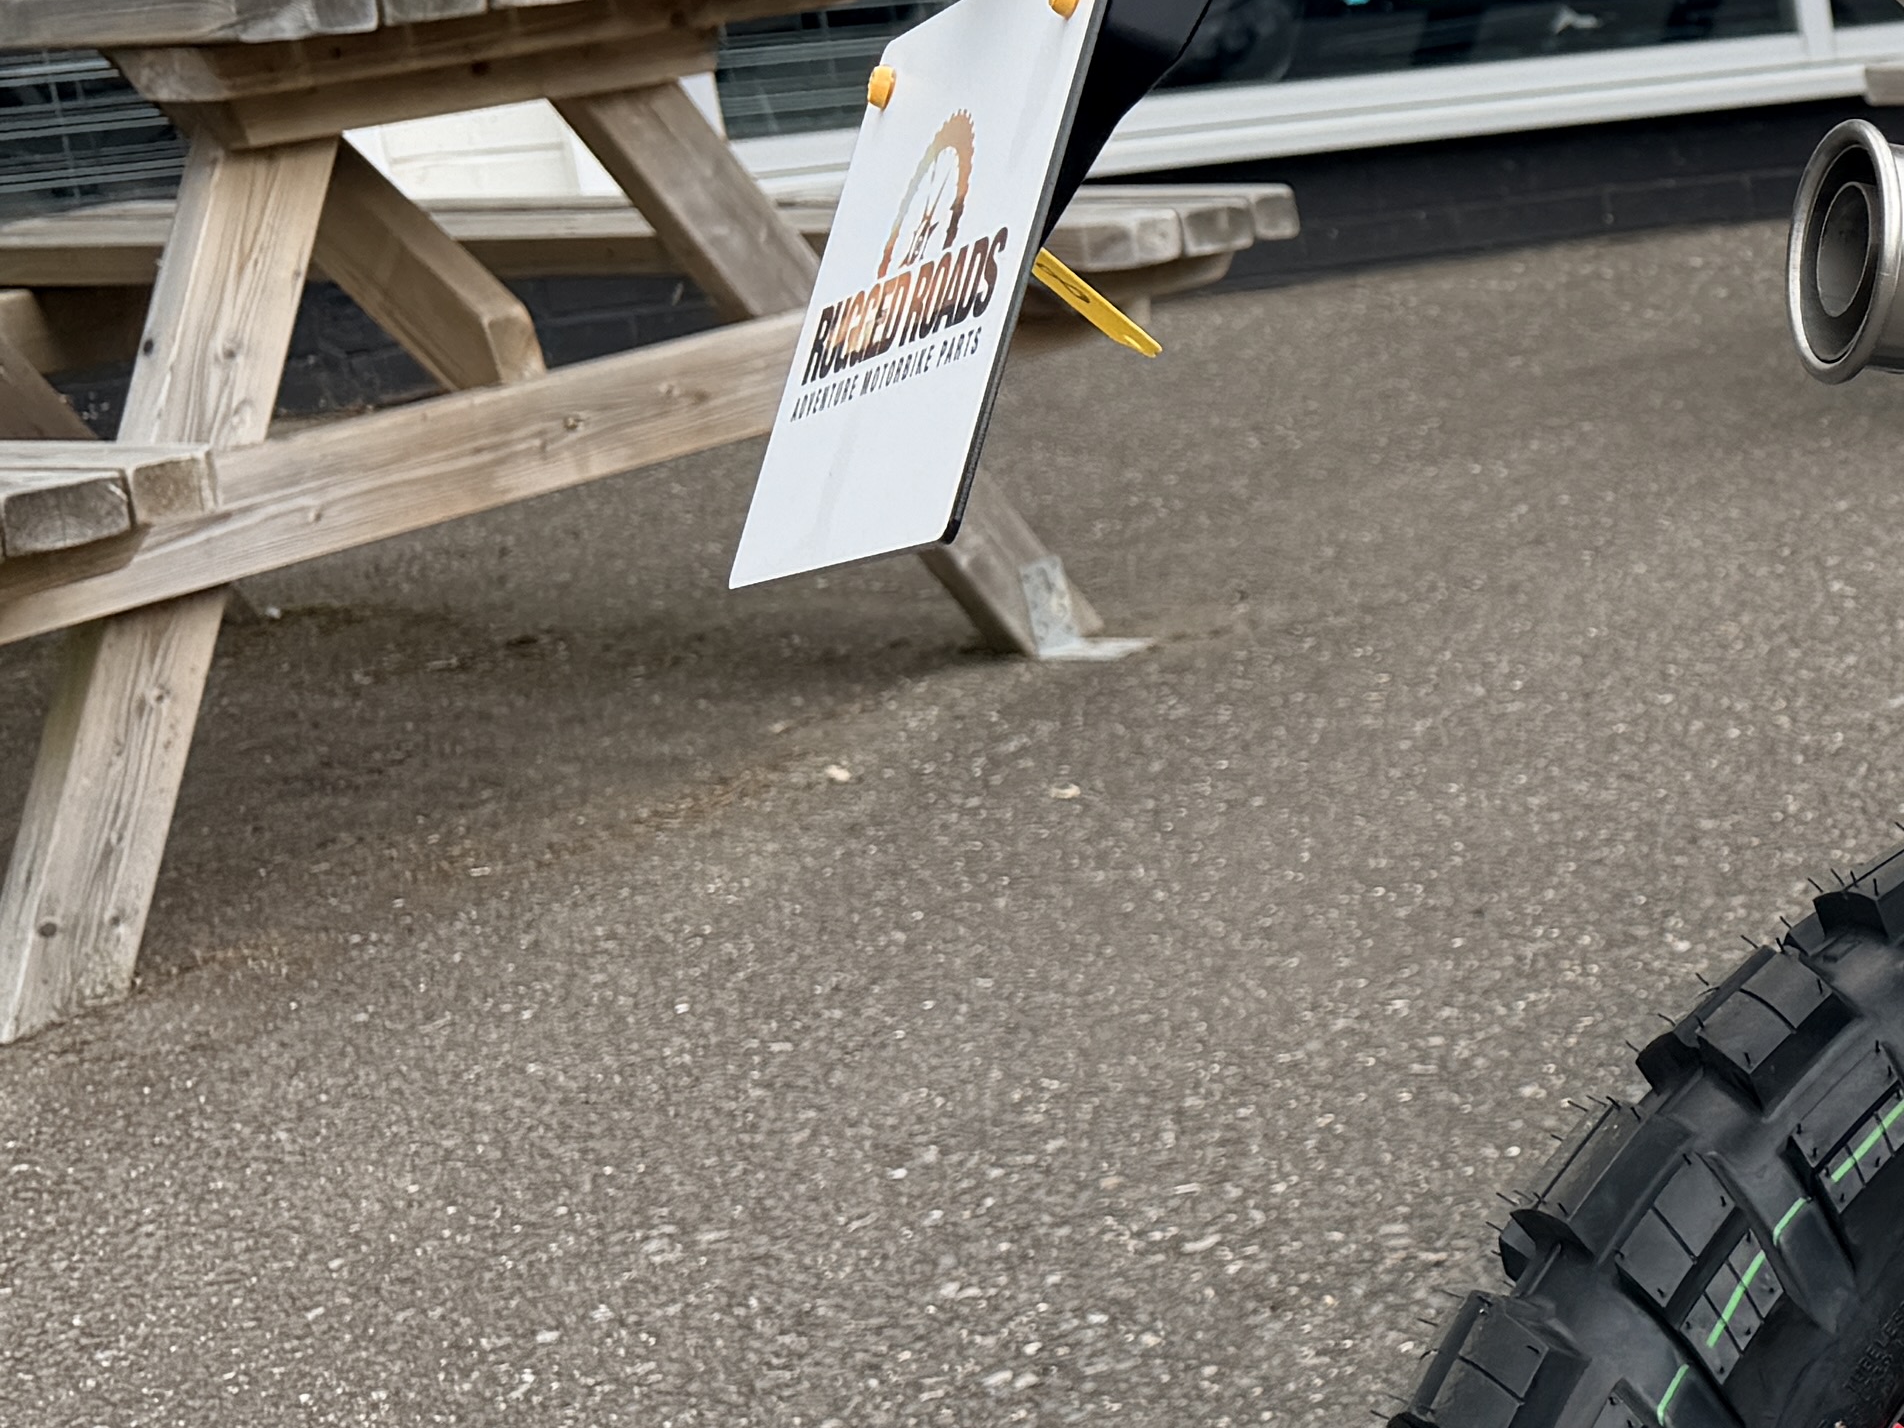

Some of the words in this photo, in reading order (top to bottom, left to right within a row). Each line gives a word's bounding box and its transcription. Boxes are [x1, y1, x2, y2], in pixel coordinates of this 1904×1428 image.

[801, 270, 912, 387] RUGGED
[898, 227, 1009, 348] ROADS
[790, 374, 859, 423] ADVENTURE
[859, 344, 935, 396] MOTORBIKE
[936, 326, 983, 368] PARTS
